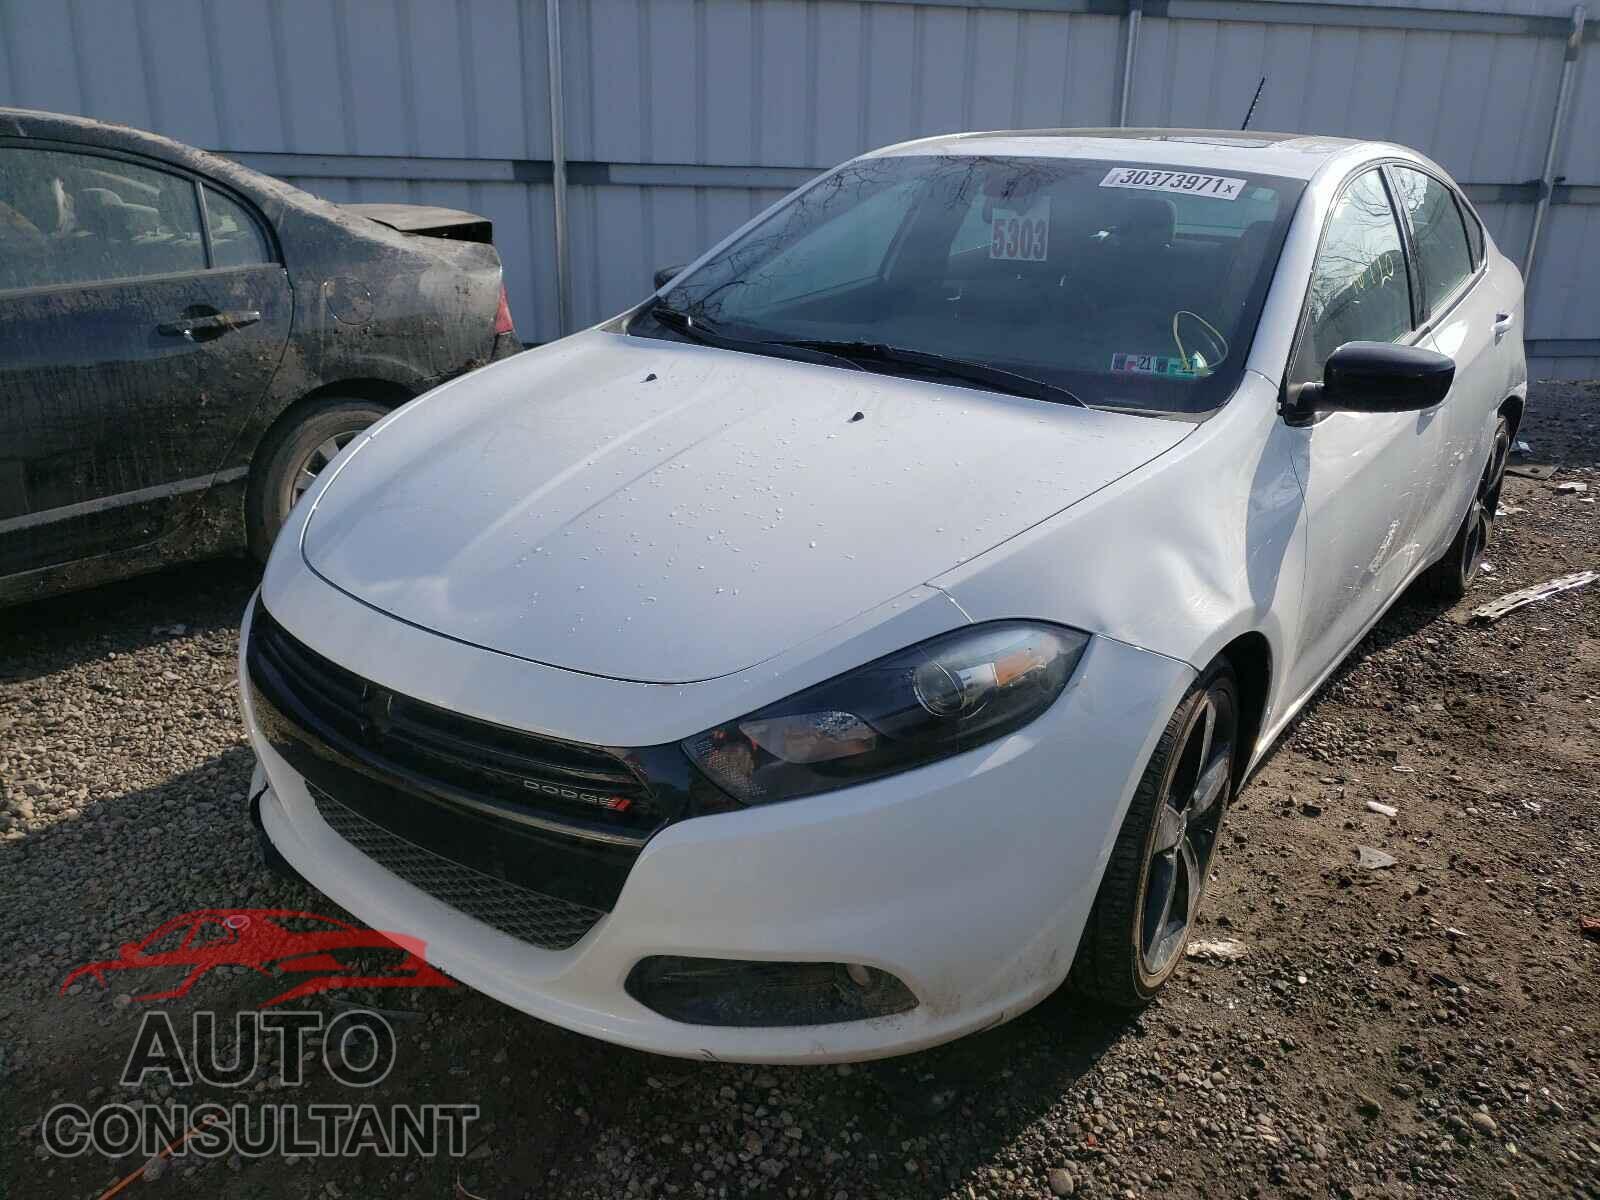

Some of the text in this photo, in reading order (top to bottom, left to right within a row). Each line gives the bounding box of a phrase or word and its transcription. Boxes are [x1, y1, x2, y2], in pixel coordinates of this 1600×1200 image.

[1119, 169, 1224, 193] 30373971
[991, 218, 1047, 259] 5303
[1140, 355, 1151, 370] 21
[523, 780, 617, 808] DODGE
